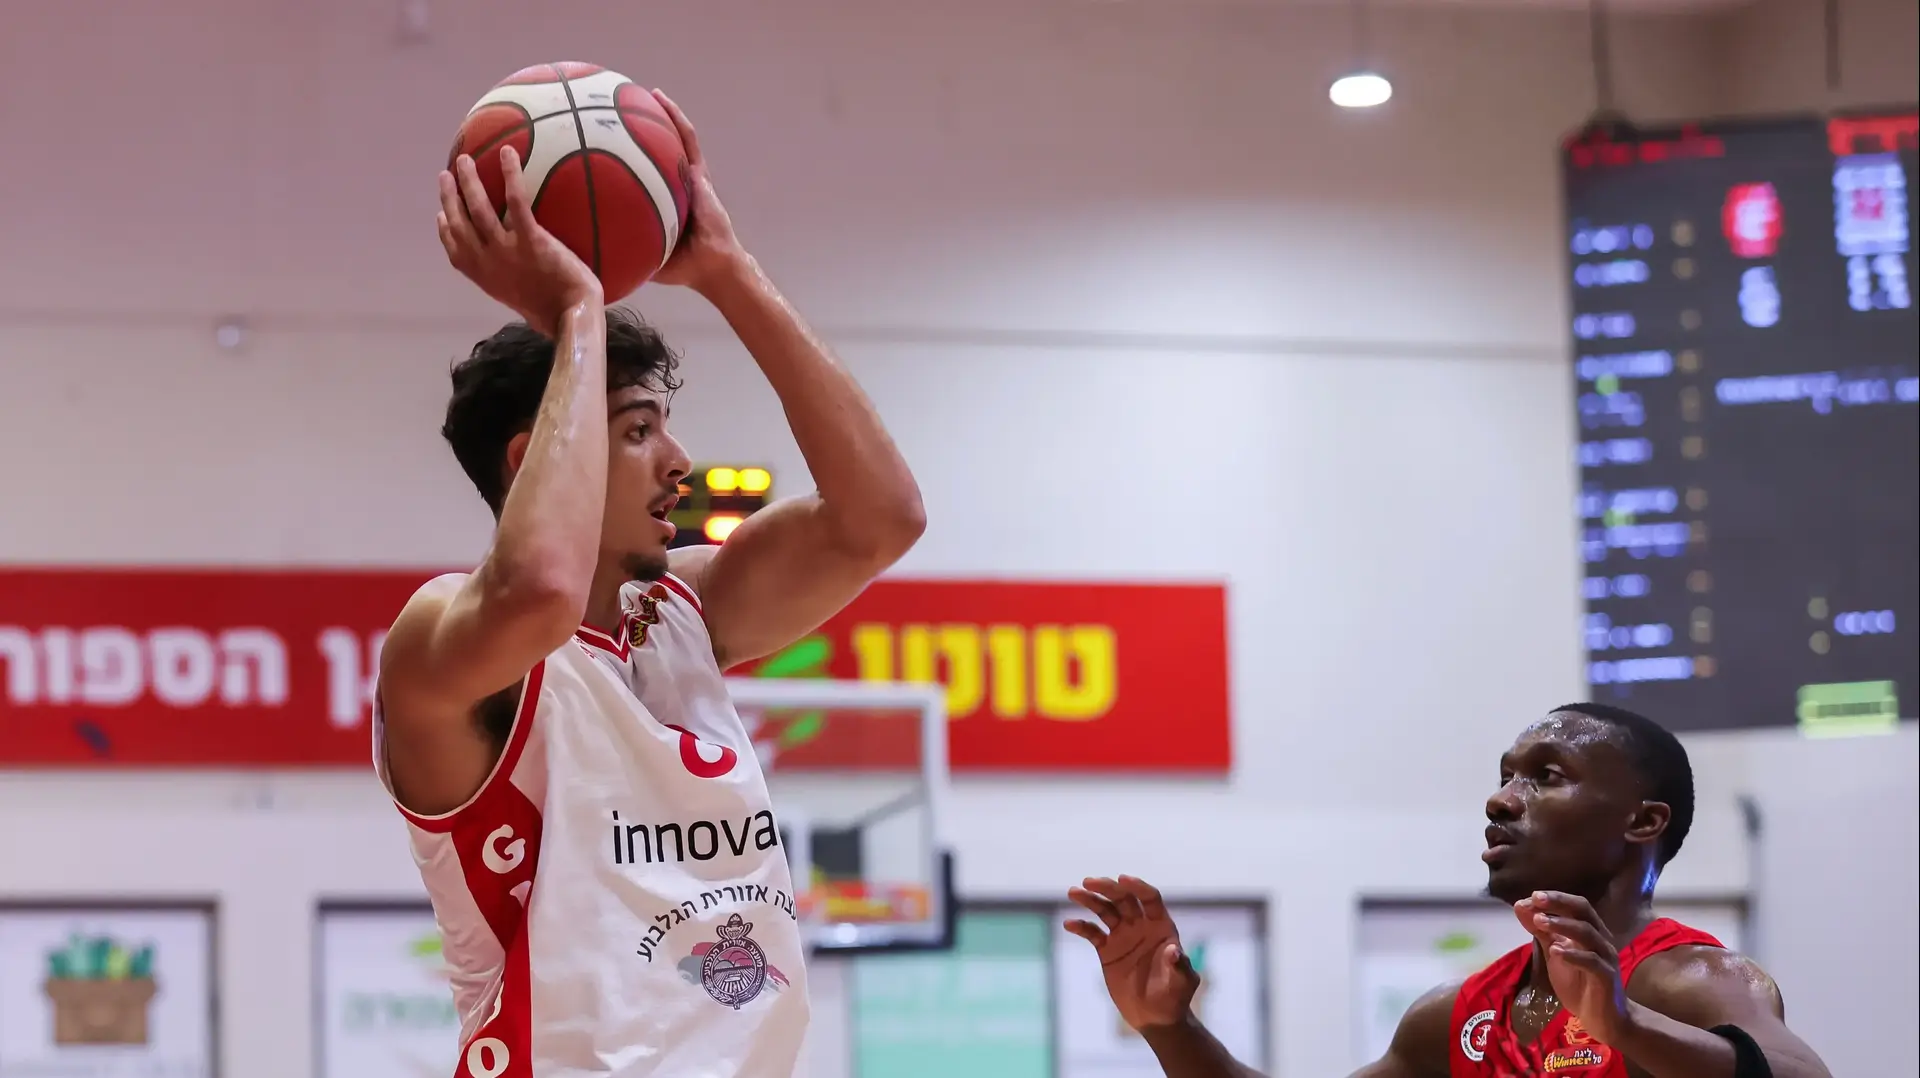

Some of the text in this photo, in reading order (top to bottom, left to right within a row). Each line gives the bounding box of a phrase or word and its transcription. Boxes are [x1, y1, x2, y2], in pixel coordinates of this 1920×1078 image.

[853, 624, 1116, 720] טוטו
[612, 810, 778, 864] innova
[700, 884, 768, 910] אזורית
[637, 900, 698, 963] הגלבוע
[1553, 1054, 1602, 1068] Winner סל
[1574, 1047, 1592, 1058] ליגת
